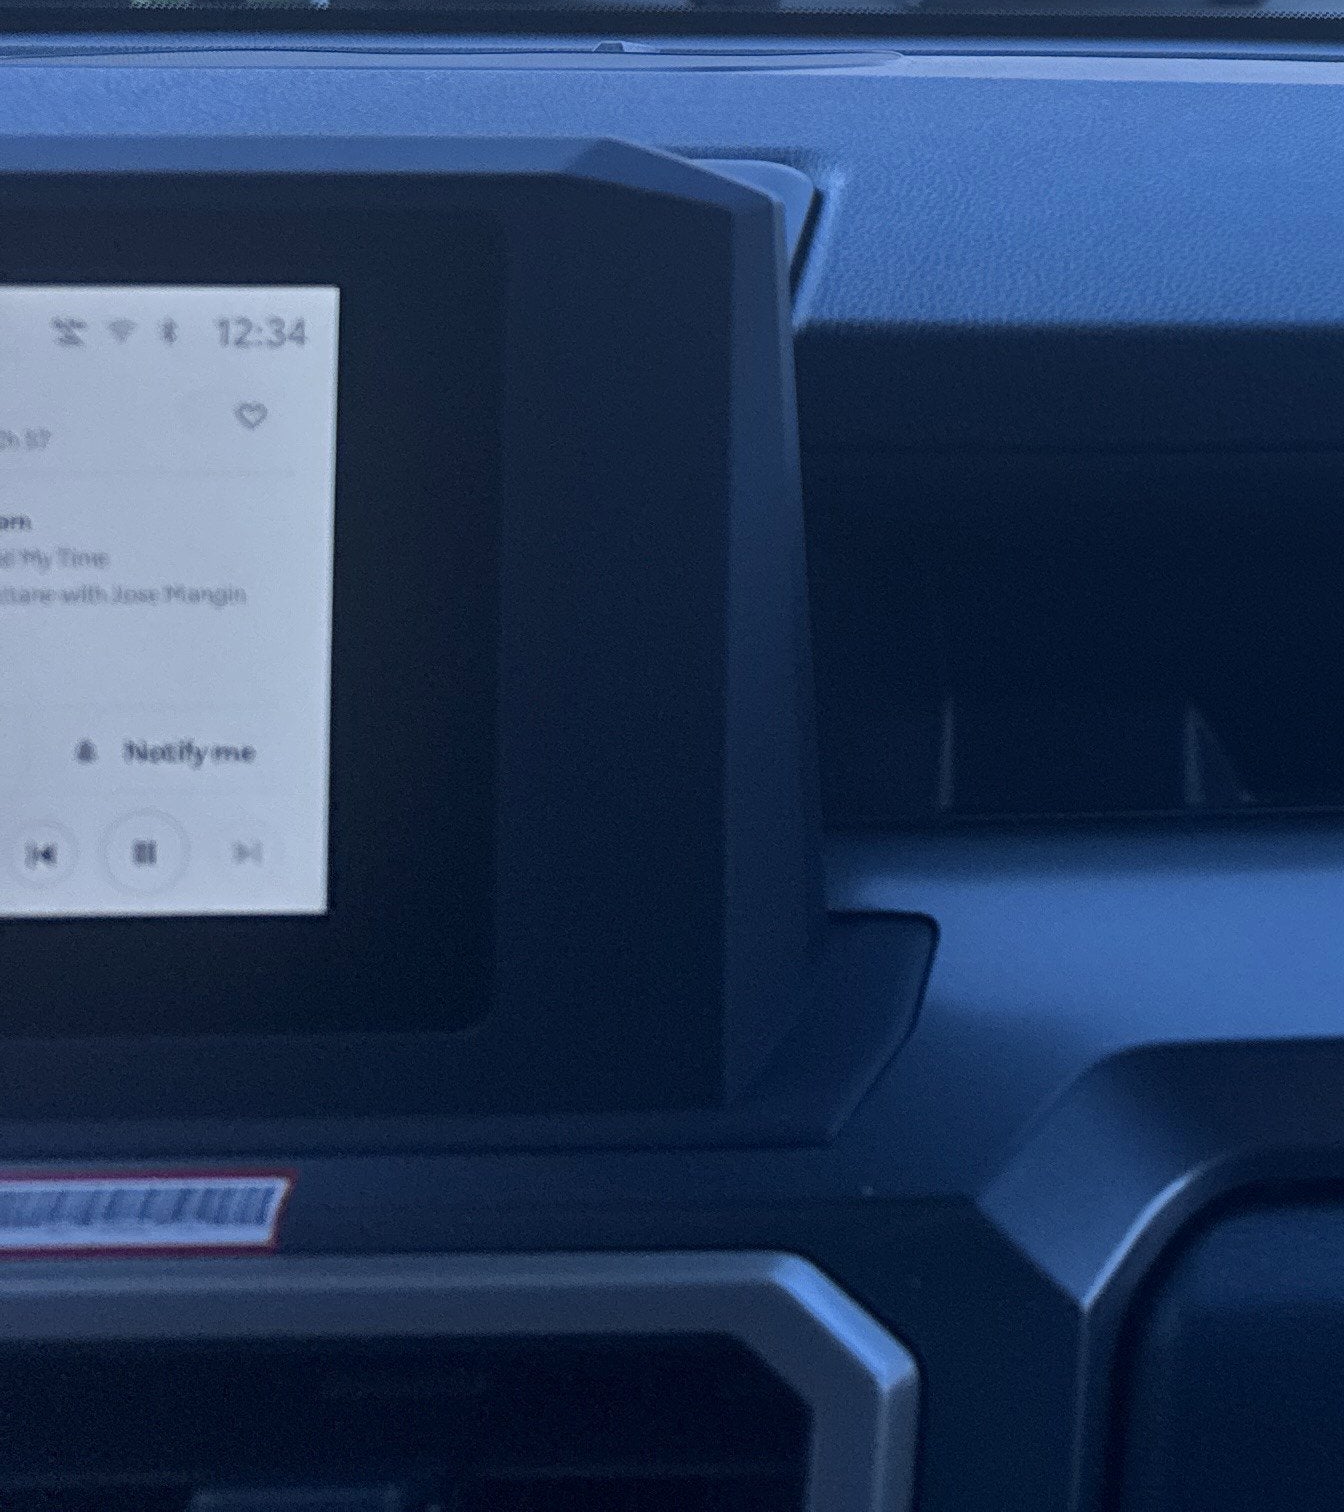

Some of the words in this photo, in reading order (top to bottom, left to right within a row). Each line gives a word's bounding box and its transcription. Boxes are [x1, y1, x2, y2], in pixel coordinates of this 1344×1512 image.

[214, 315, 309, 349] 12:34
[56, 544, 110, 568] Time
[58, 585, 108, 607] with
[122, 738, 208, 771] Notify
[211, 744, 257, 764] me
